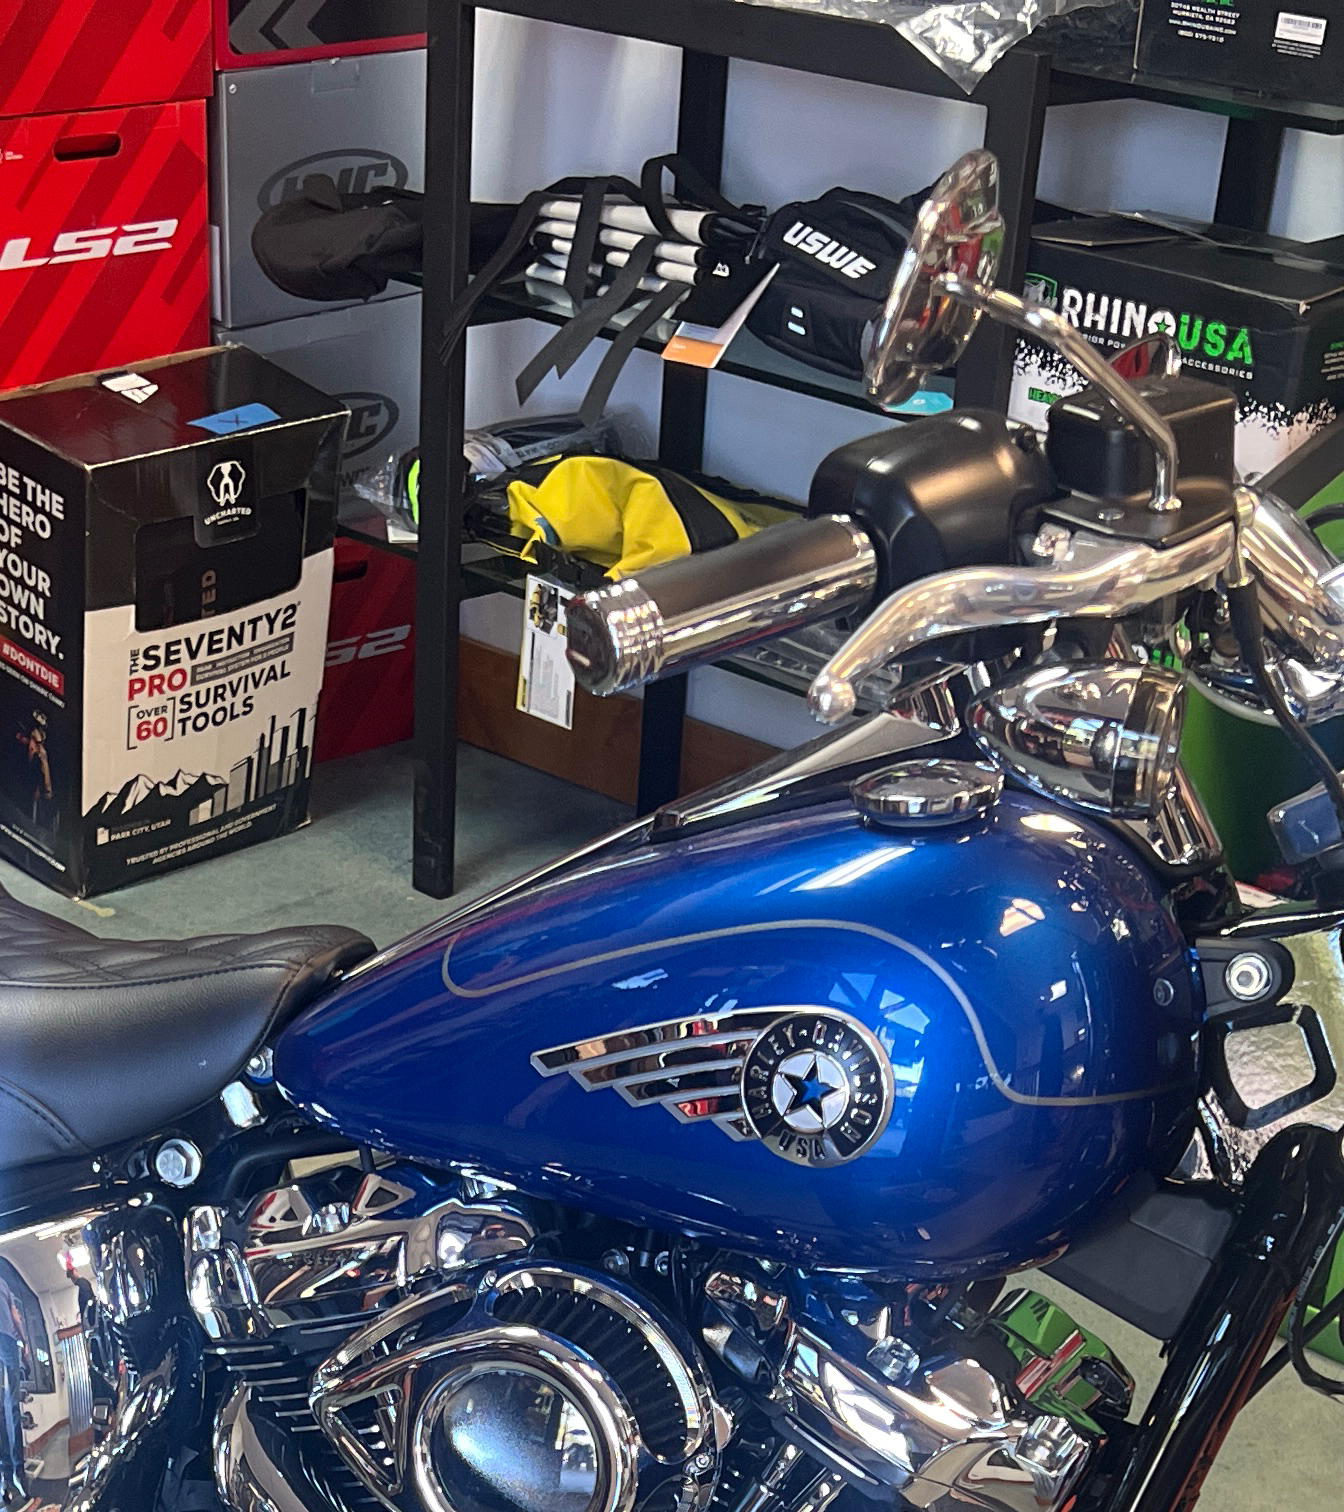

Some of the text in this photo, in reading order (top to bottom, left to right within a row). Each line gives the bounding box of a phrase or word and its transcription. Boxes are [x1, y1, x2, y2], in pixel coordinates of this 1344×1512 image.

[783, 221, 876, 279] USWE
[1062, 286, 1254, 367] RHINO USA
[1180, 355, 1254, 381] ACCESSORIES
[23, 475, 65, 520] THE
[204, 506, 252, 526] UNCHARTED
[129, 648, 141, 676] THE
[141, 602, 298, 672] SEVENTY2
[325, 624, 411, 668] S2
[1, 642, 60, 690] #DONTDIE
[128, 668, 188, 702] PRO
[179, 660, 291, 713] SURVIVAL
[136, 705, 168, 719] OVER
[136, 717, 168, 741] 60
[178, 695, 254, 737] TOOLS
[778, 1130, 826, 1160] USA
